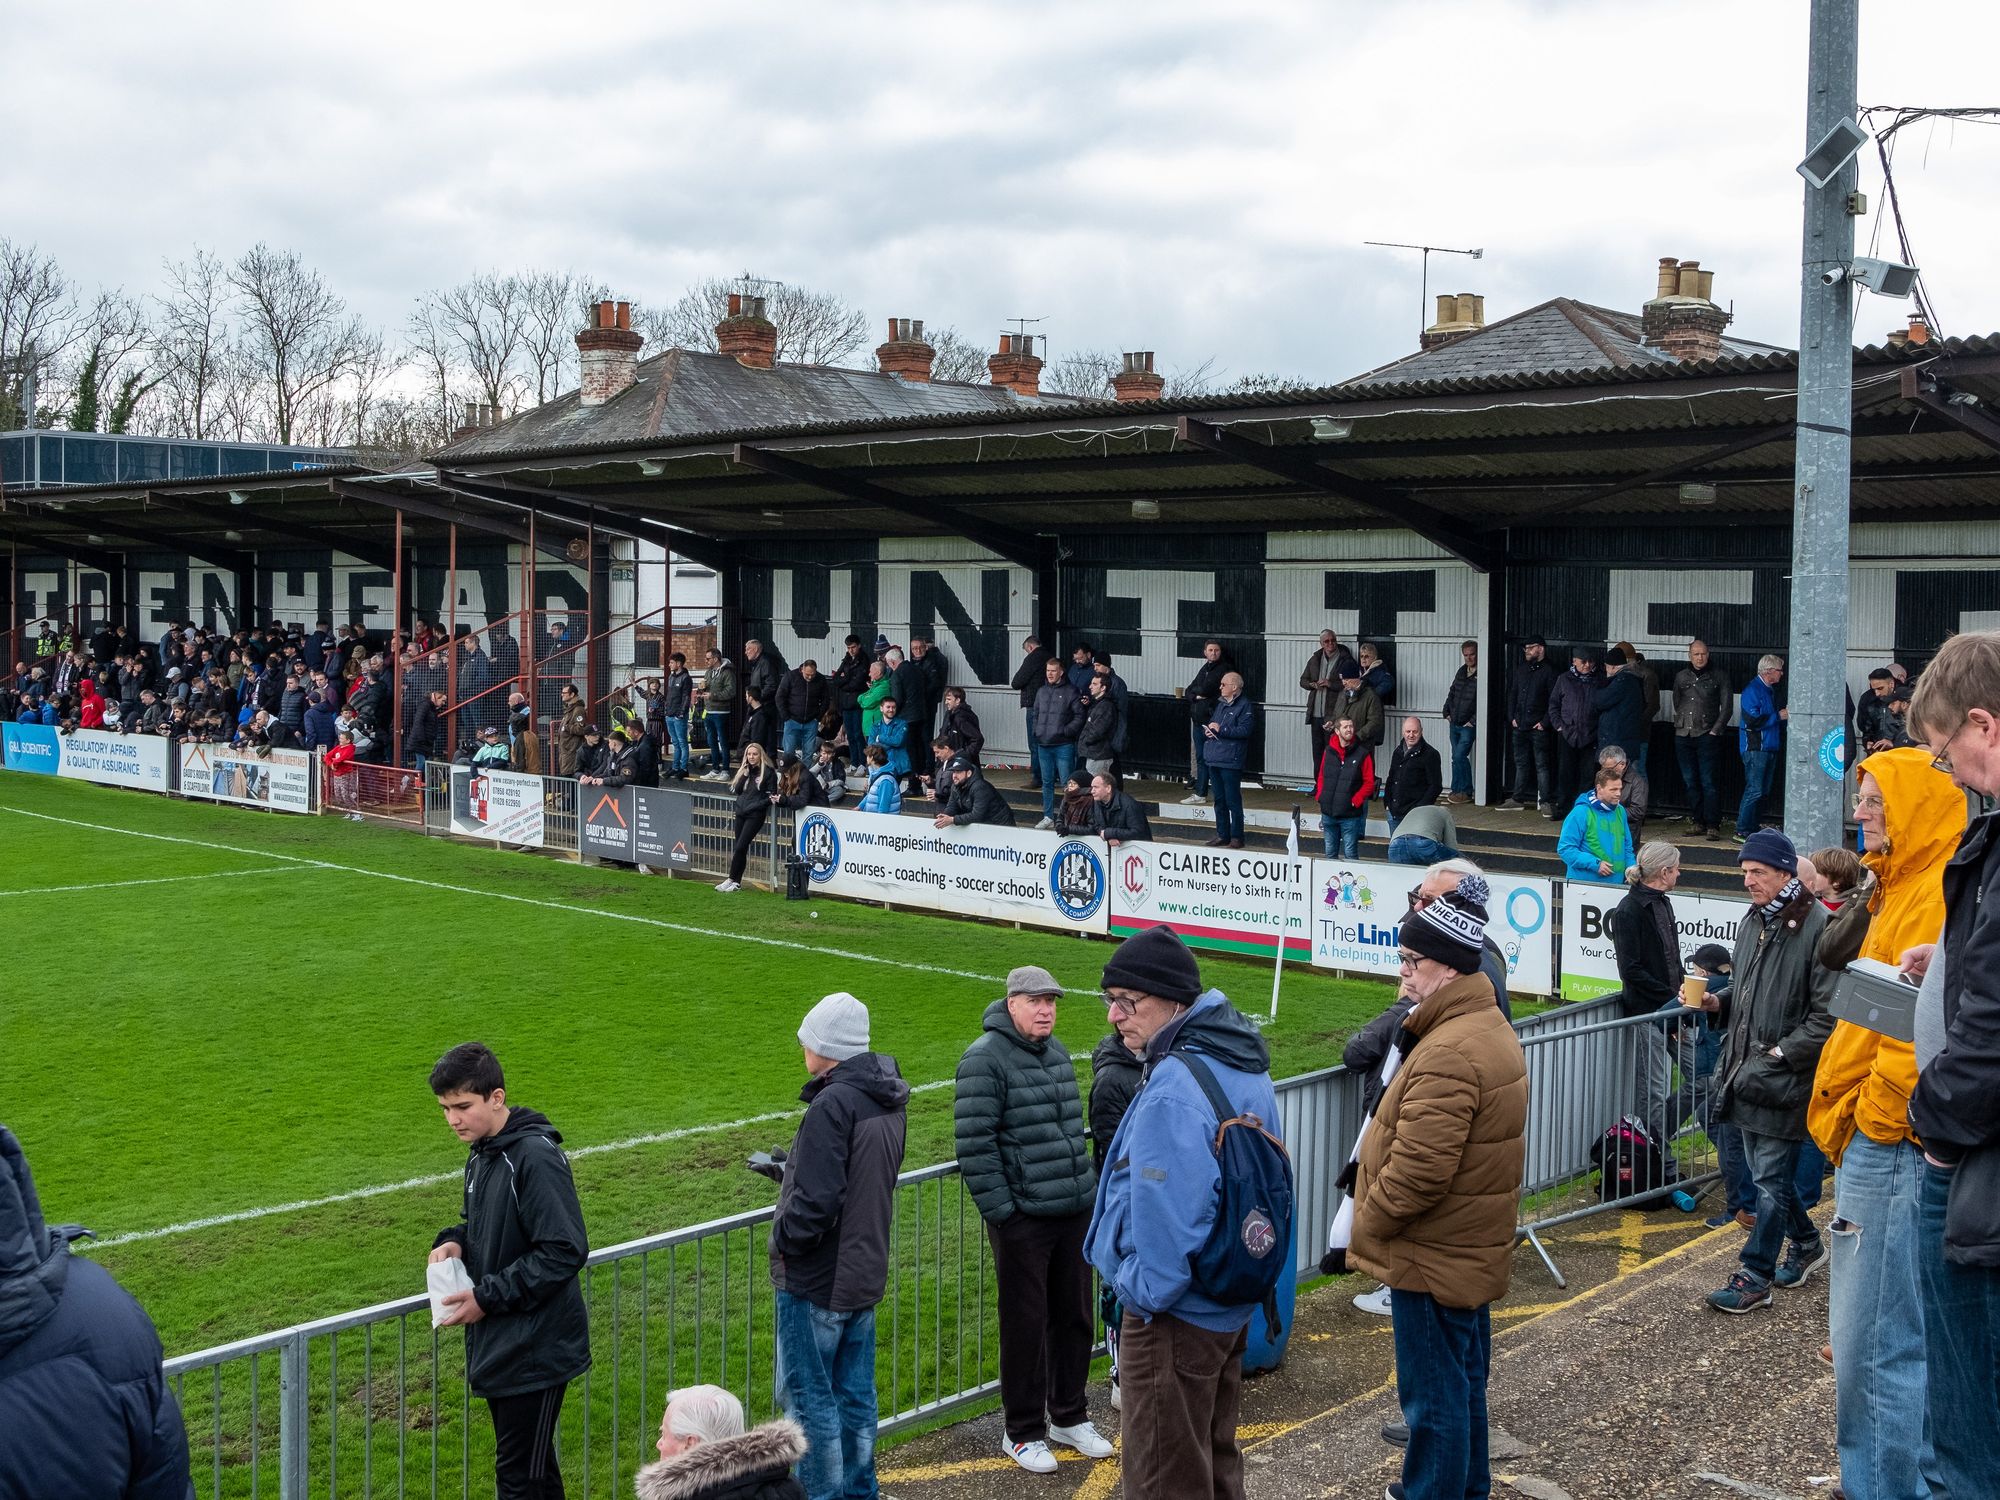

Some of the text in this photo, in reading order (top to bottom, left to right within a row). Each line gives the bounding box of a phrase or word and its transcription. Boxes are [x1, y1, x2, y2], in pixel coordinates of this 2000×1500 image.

[22, 742, 52, 757] SCIENTIFIC
[66, 738, 137, 758] REGULATORY AFFAIRS
[1821, 729, 1839, 750] PLEASE
[67, 756, 140, 776] & QUALITY ASSURANCE
[807, 815, 832, 829] MAGPIES
[586, 824, 605, 838] GADD'S
[606, 826, 629, 842] ROOFING
[845, 830, 1047, 870] www.magpiesinthecommunity.org
[1061, 844, 1093, 859] MAGPIES
[1158, 851, 1230, 877] CLAIRES
[844, 861, 886, 879] courses
[895, 866, 946, 890] coaching
[955, 874, 995, 894] soccer
[997, 878, 1045, 900] schools
[1158, 876, 1184, 888] From
[1187, 879, 1227, 896] Nursery
[1231, 884, 1242, 895] to
[1245, 885, 1271, 899] Sixth
[1058, 900, 1068, 913] THE
[1068, 897, 1100, 917] COMMUNITY
[1676, 918, 1738, 941] ootball
[1319, 944, 1400, 965] A helping ha
[1580, 945, 1602, 958] Your
[1572, 983, 1592, 993] PLAY
